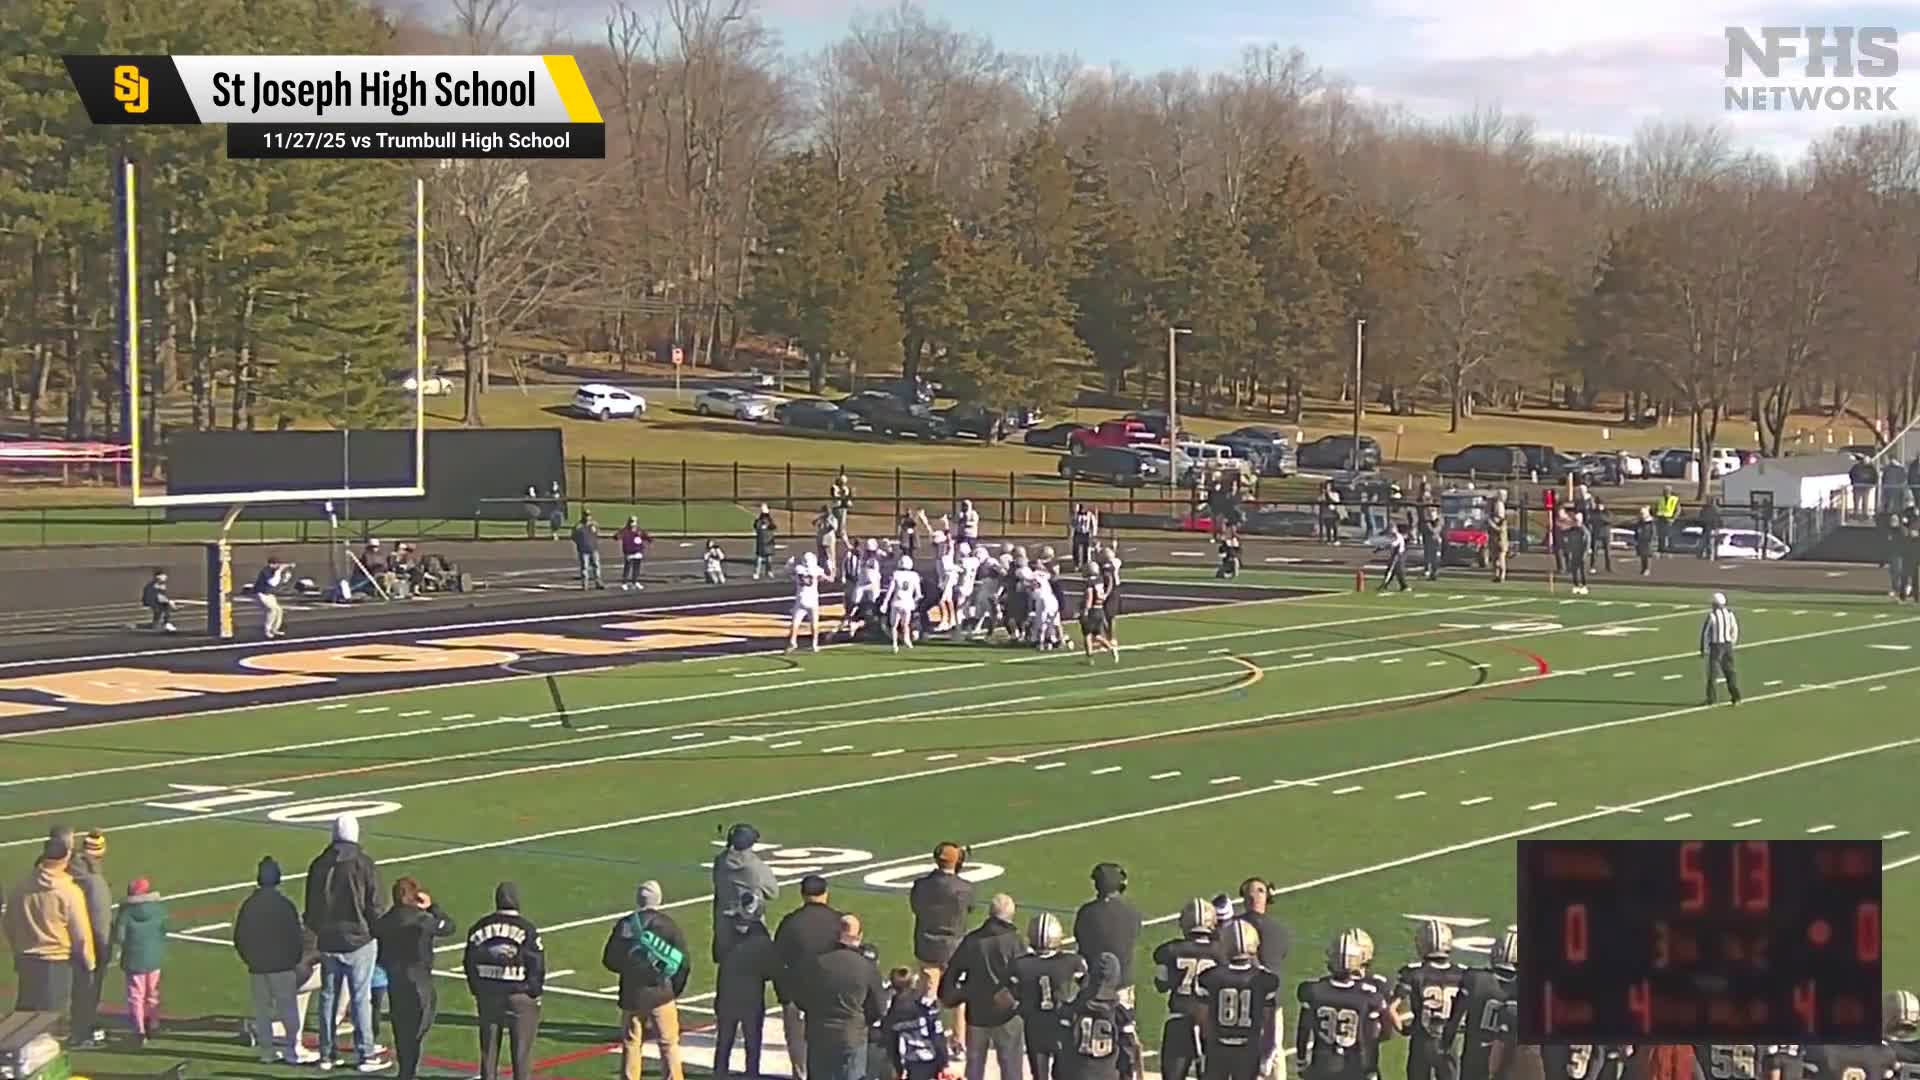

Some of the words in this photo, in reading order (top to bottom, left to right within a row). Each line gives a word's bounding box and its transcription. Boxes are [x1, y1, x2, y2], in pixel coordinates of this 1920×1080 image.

[1039, 976, 1053, 1010] 1
[1219, 988, 1252, 1027] 81
[1078, 1017, 1113, 1057] 16
